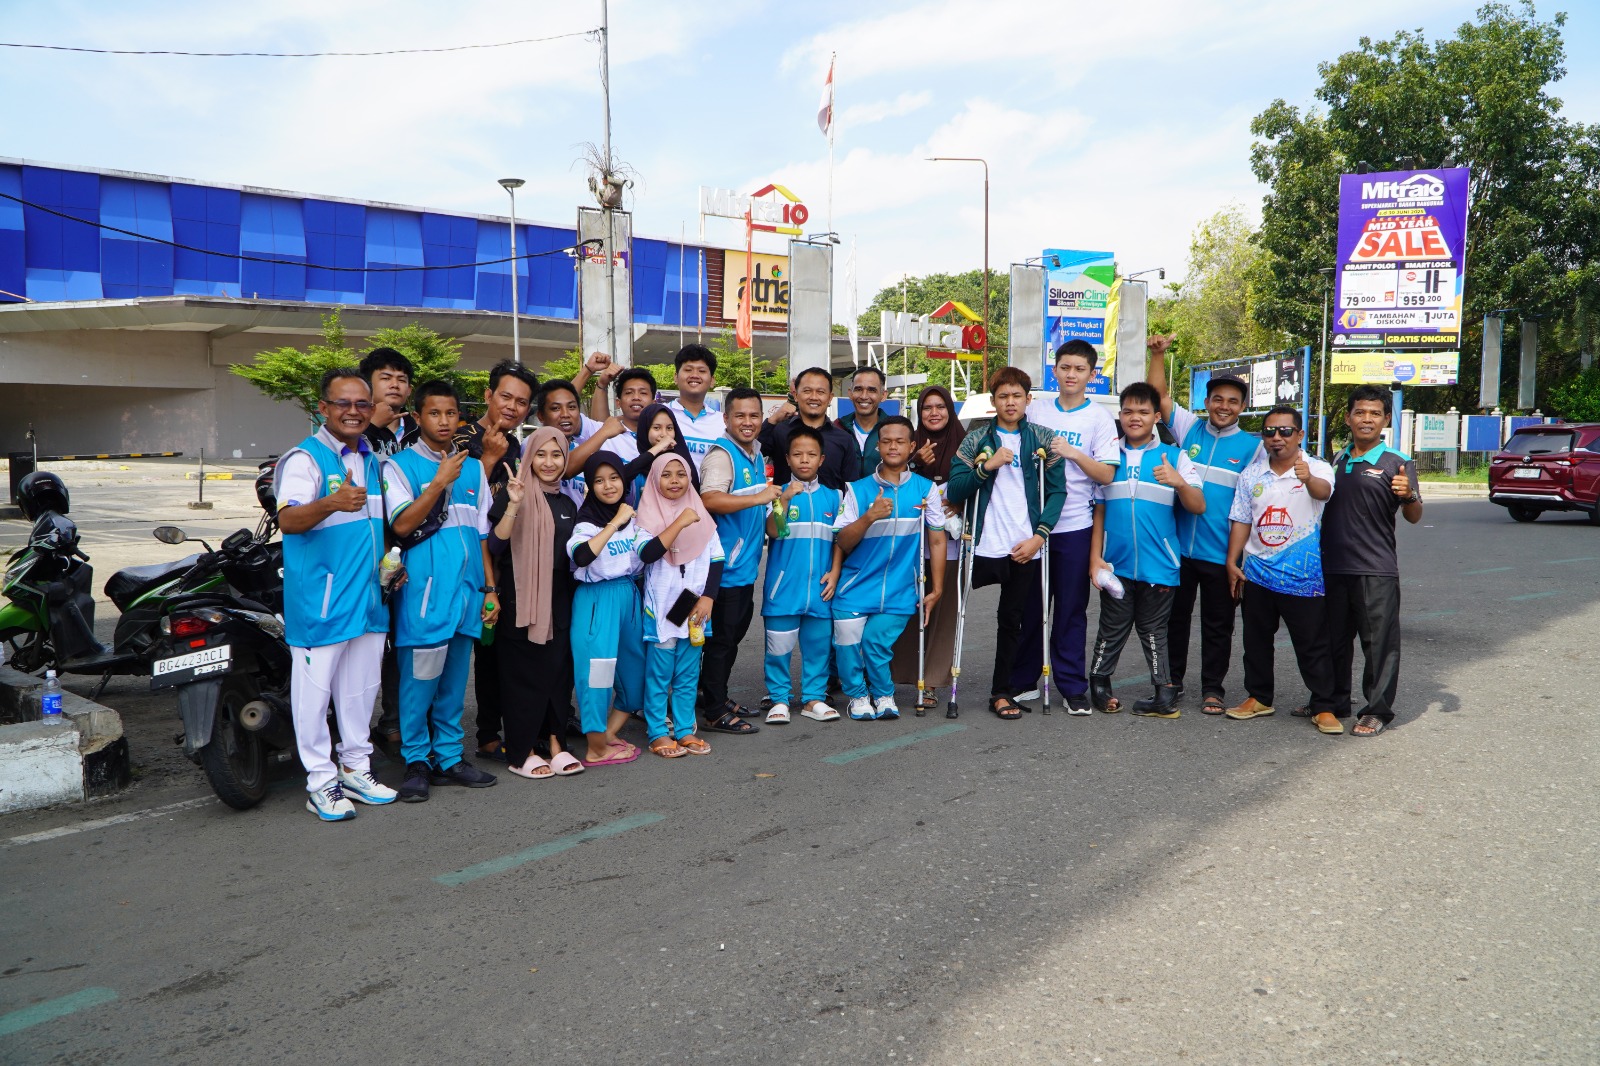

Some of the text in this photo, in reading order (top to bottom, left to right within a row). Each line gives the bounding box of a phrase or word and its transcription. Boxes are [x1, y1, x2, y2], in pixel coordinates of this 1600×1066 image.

[1361, 181, 1445, 200] Mitra10
[1368, 219, 1434, 231] MID YEAR
[1357, 231, 1446, 258] SALE
[1431, 312, 1455, 320] JUTA
[881, 310, 986, 350] Mitra10
[1077, 321, 1099, 329] Tingkat
[1071, 330, 1102, 338] Kesehatan
[1421, 335, 1457, 343] ONGKIR
[1333, 360, 1356, 372] atria
